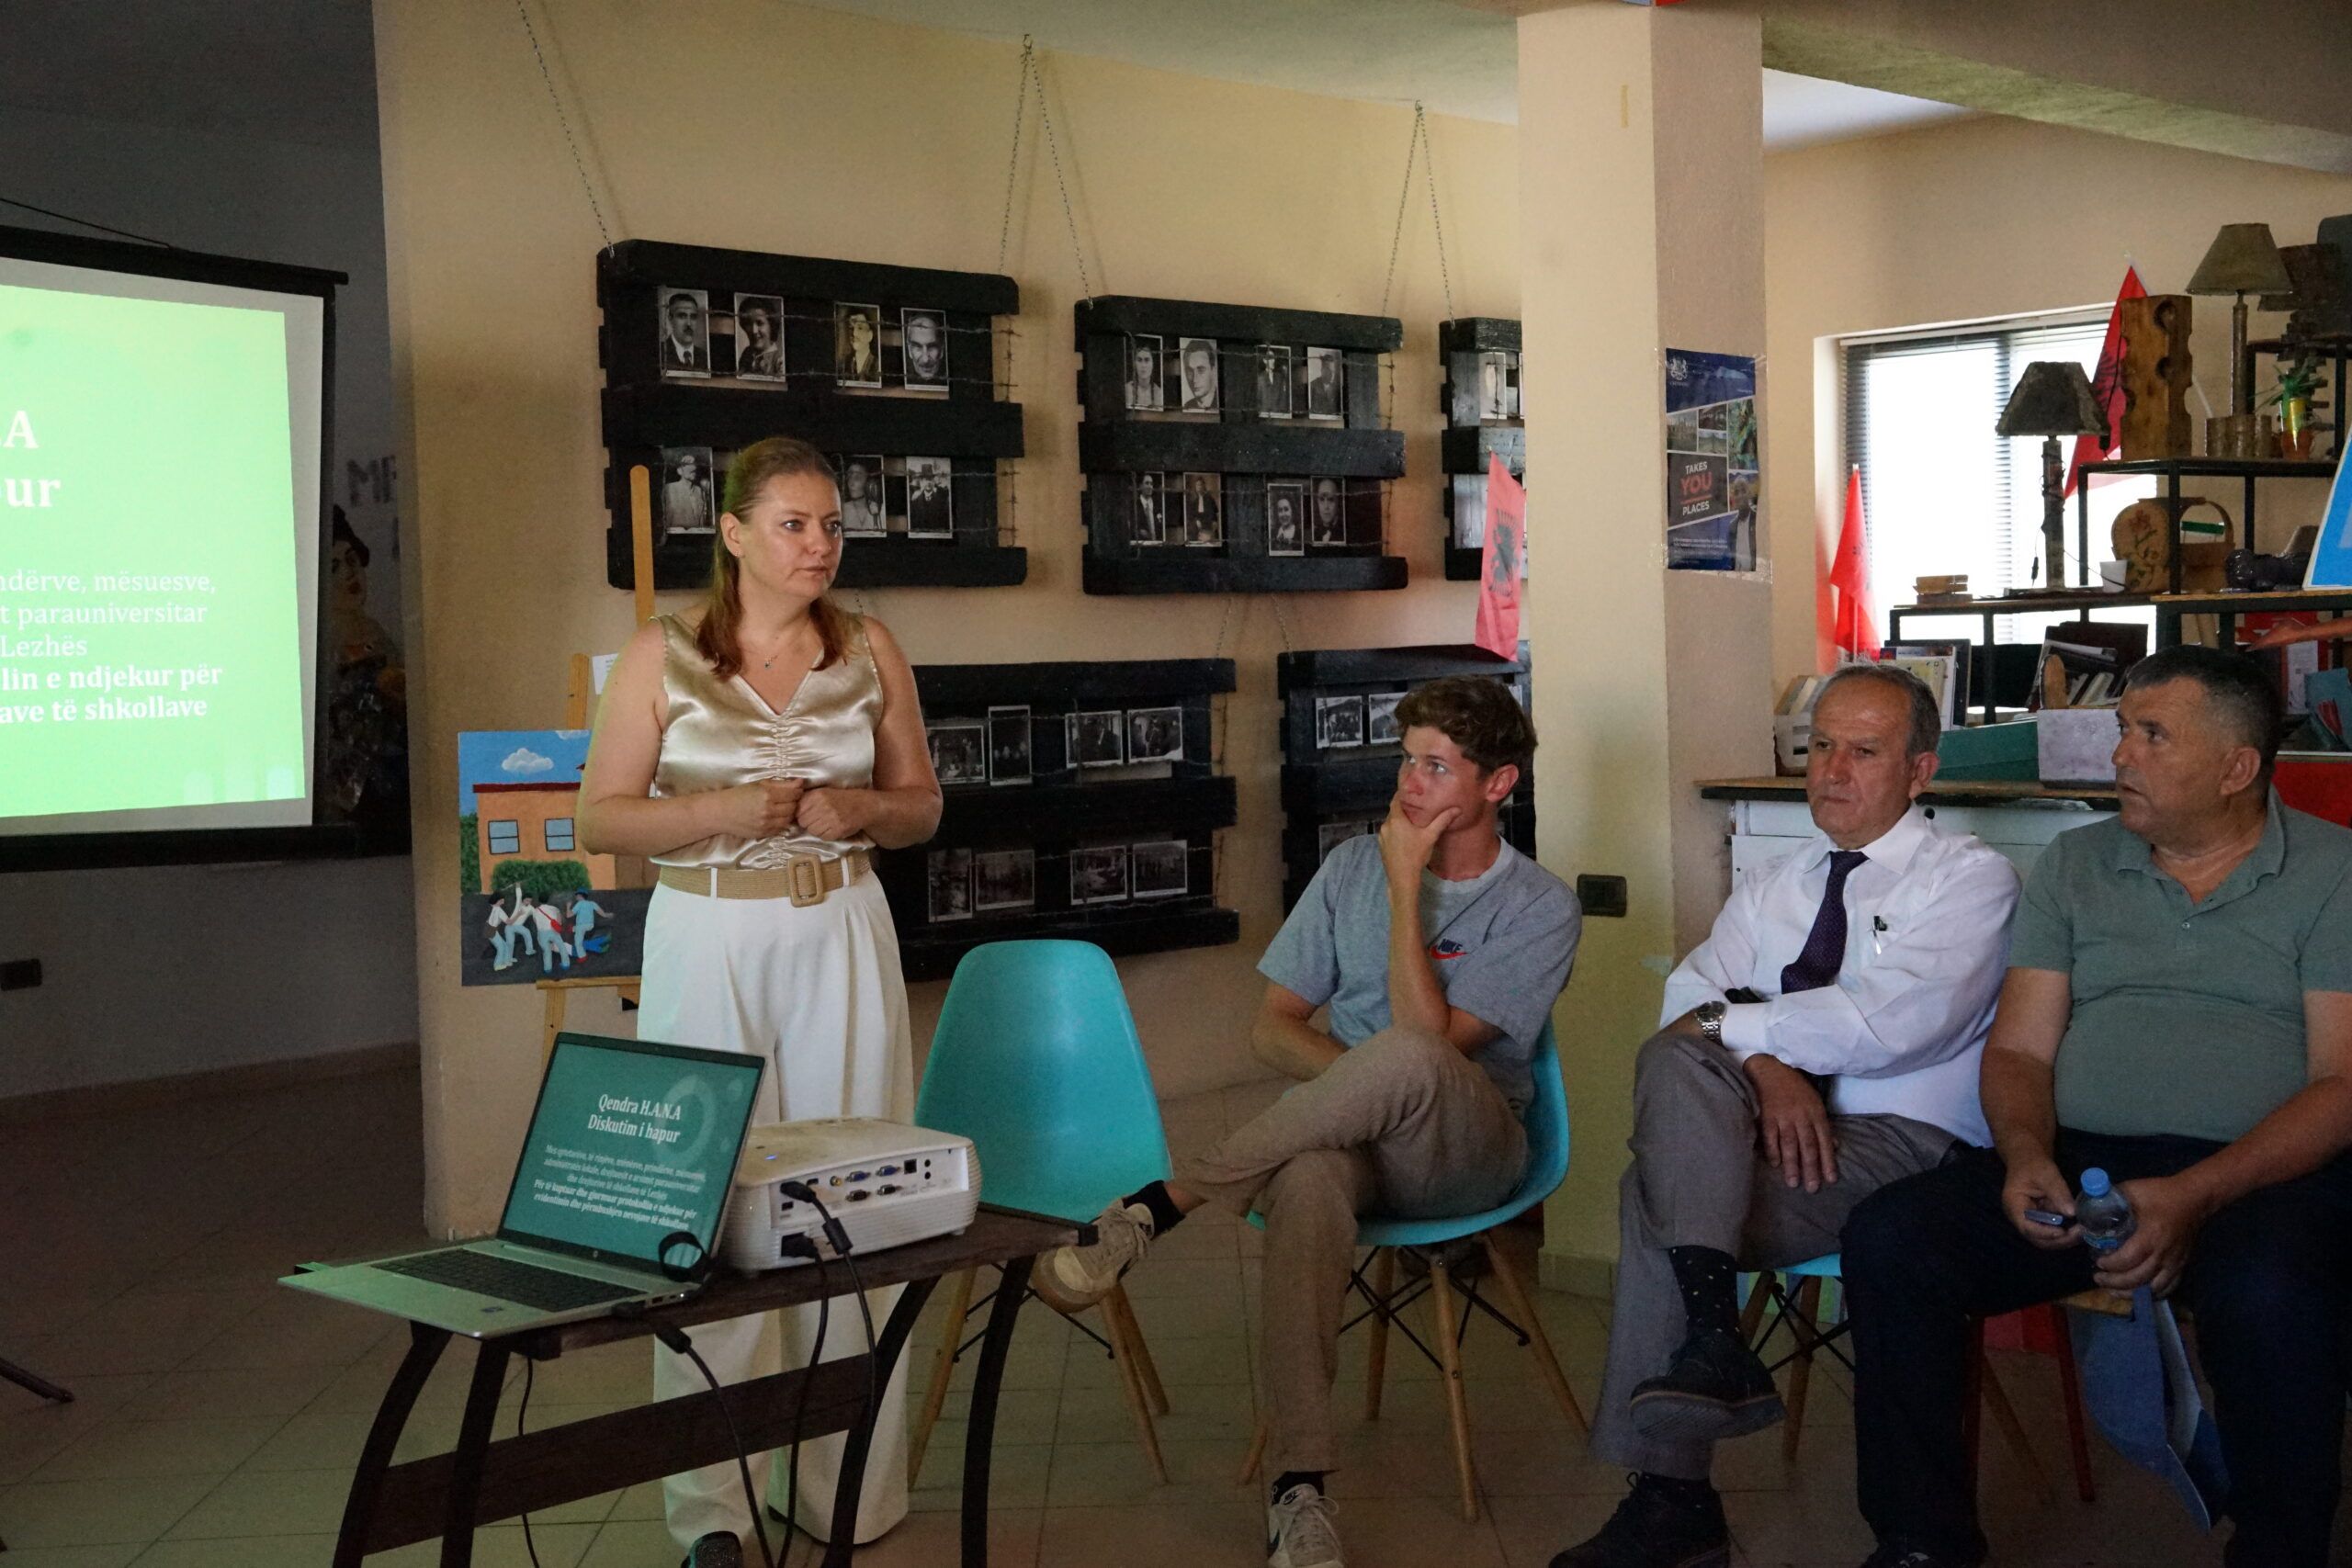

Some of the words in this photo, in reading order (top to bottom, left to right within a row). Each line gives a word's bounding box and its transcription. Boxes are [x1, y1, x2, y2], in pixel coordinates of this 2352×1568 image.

[0, 410, 40, 448] A
[1685, 461, 1708, 474] TAKES
[0, 478, 62, 507] ur
[1680, 471, 1713, 495] YOU
[1682, 501, 1710, 515] PLACES
[95, 570, 216, 594] mësuesve,
[17, 602, 208, 630] parauniversitar
[0, 634, 88, 658] Lezhës
[46, 671, 62, 689] e
[69, 664, 174, 693] ndjekur
[180, 663, 223, 691] për
[51, 699, 77, 722] të
[85, 695, 208, 720] shkollave
[1438, 939, 1463, 953] NIKE
[598, 1094, 639, 1114] Qendra
[639, 1100, 681, 1120] H.A.N.A
[588, 1114, 638, 1136] Diskutim
[639, 1122, 645, 1137] i
[645, 1122, 681, 1145] hapur
